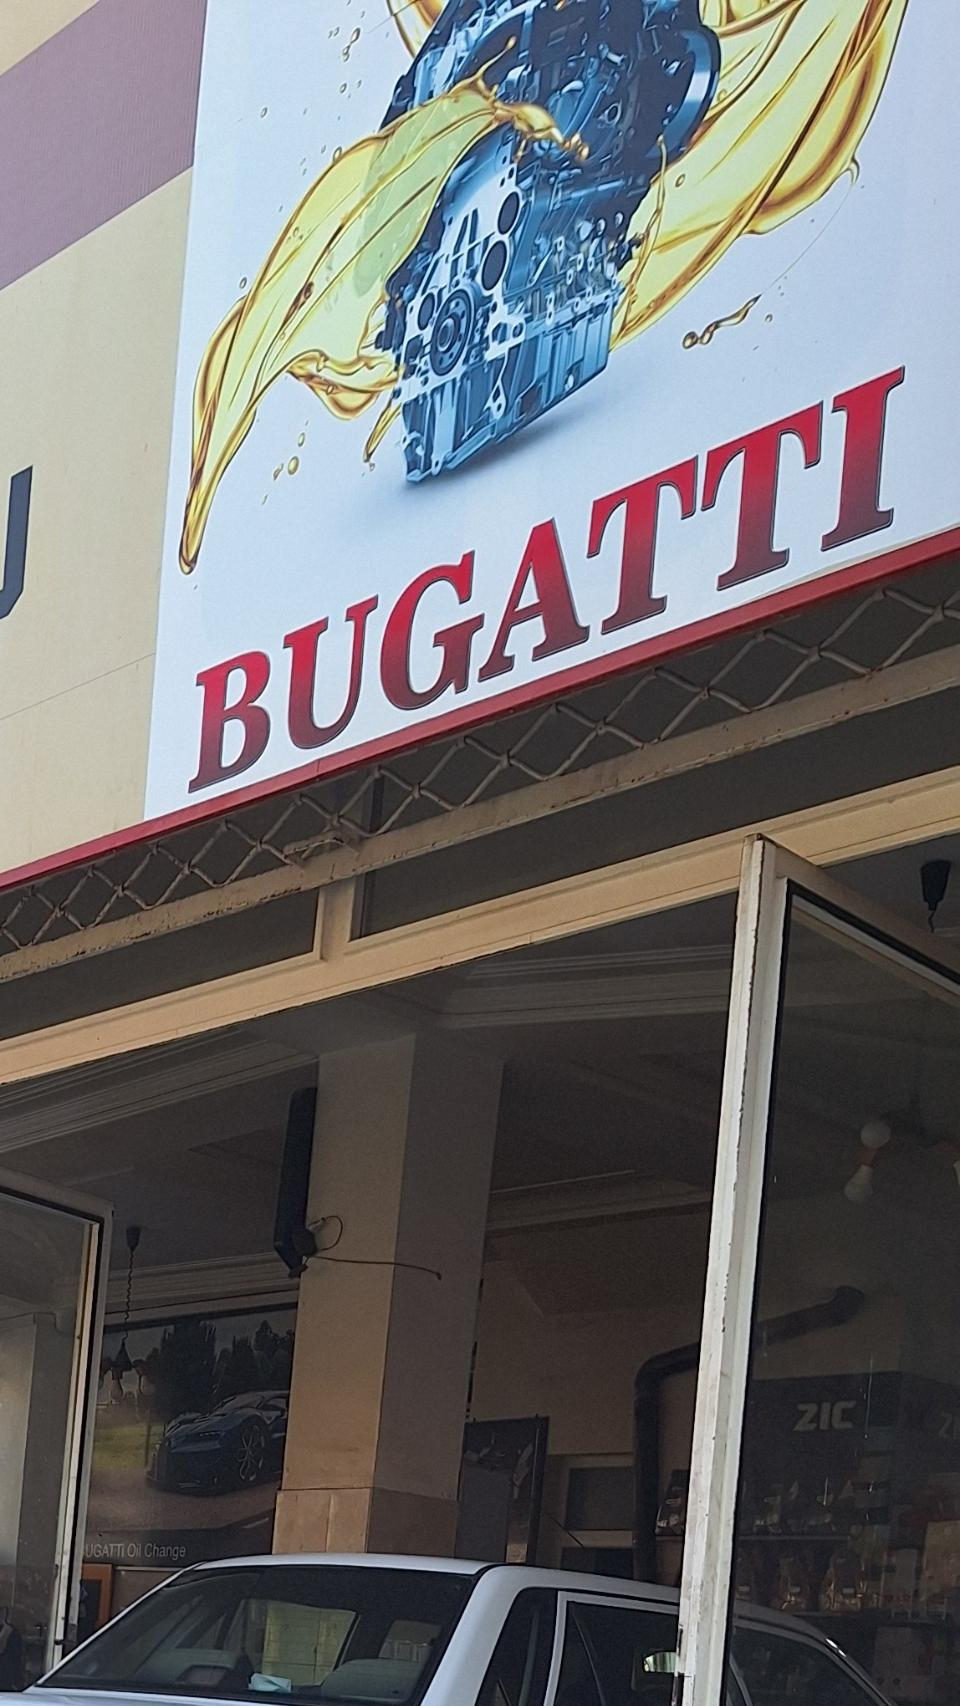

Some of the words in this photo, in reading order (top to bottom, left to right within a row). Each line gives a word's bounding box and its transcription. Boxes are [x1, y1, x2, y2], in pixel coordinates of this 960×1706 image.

[188, 365, 906, 794] BUGATTI
[792, 1400, 857, 1432] ZIC
[83, 1543, 125, 1558] UGATTI
[127, 1543, 142, 1558] Oil
[144, 1543, 187, 1561] Change
